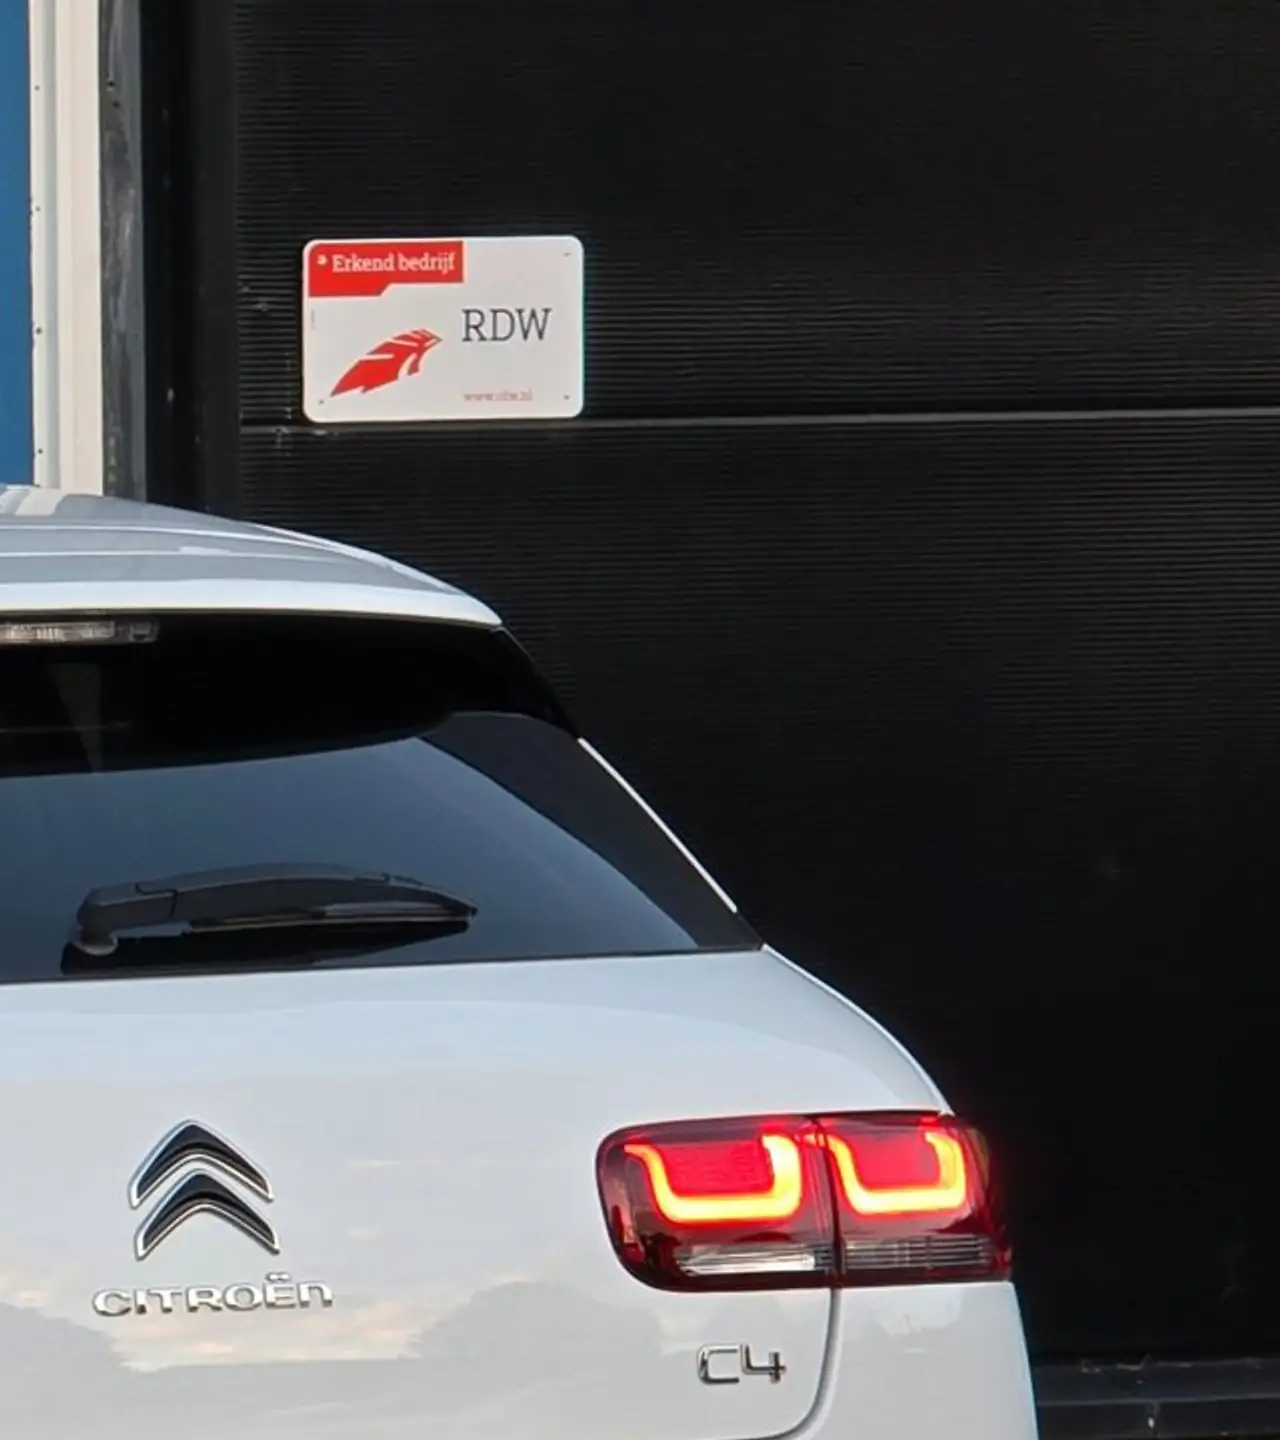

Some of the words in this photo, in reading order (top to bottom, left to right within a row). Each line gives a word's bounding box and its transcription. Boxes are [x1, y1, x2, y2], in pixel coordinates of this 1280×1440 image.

[332, 254, 395, 272] Erkend
[398, 252, 456, 274] bedrijf
[461, 307, 552, 342] RDW
[695, 1343, 787, 1385] C4
